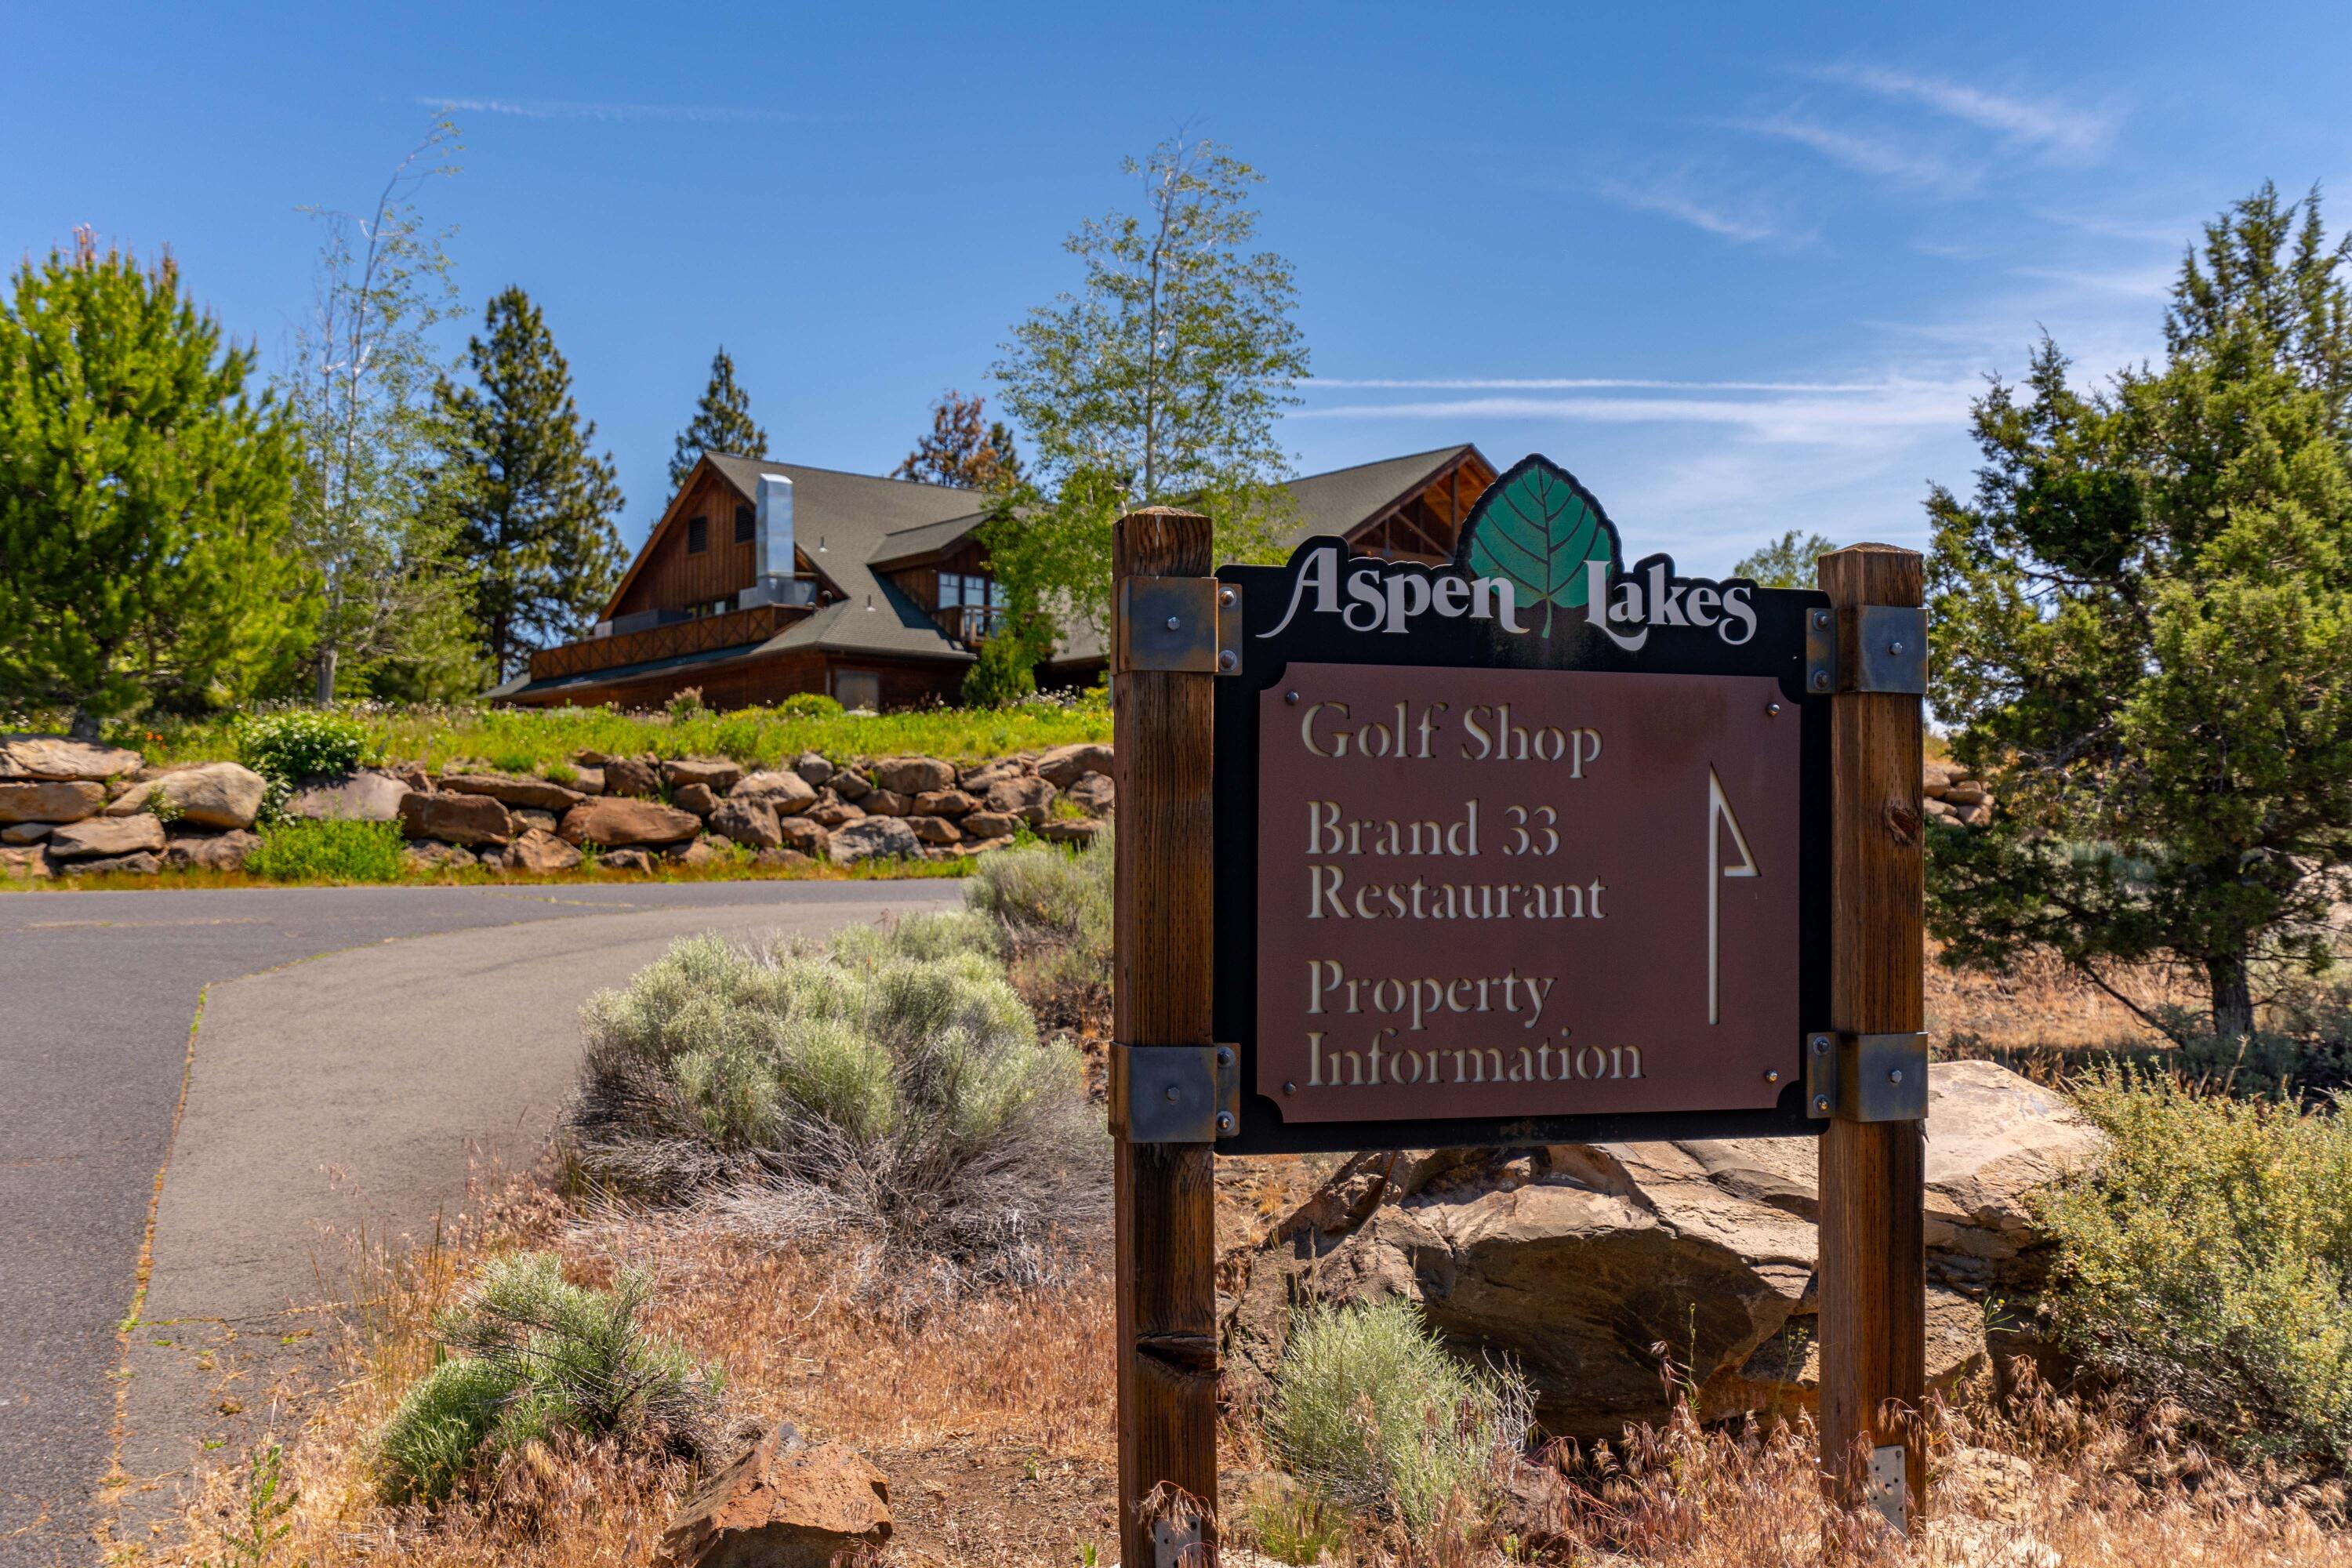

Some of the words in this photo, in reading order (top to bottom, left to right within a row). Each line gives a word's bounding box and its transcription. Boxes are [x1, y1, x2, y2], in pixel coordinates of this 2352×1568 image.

[1256, 548, 1530, 638] Aspen
[1584, 561, 1757, 651] Lakes
[1301, 701, 1447, 758] Golf
[1461, 703, 1603, 779] Shop
[1306, 798, 1481, 856] Brand
[1502, 805, 1562, 856] 33
[1306, 865, 1608, 919] Restaurant
[1307, 960, 1556, 1029] Property
[1307, 1028, 1647, 1087] Information
